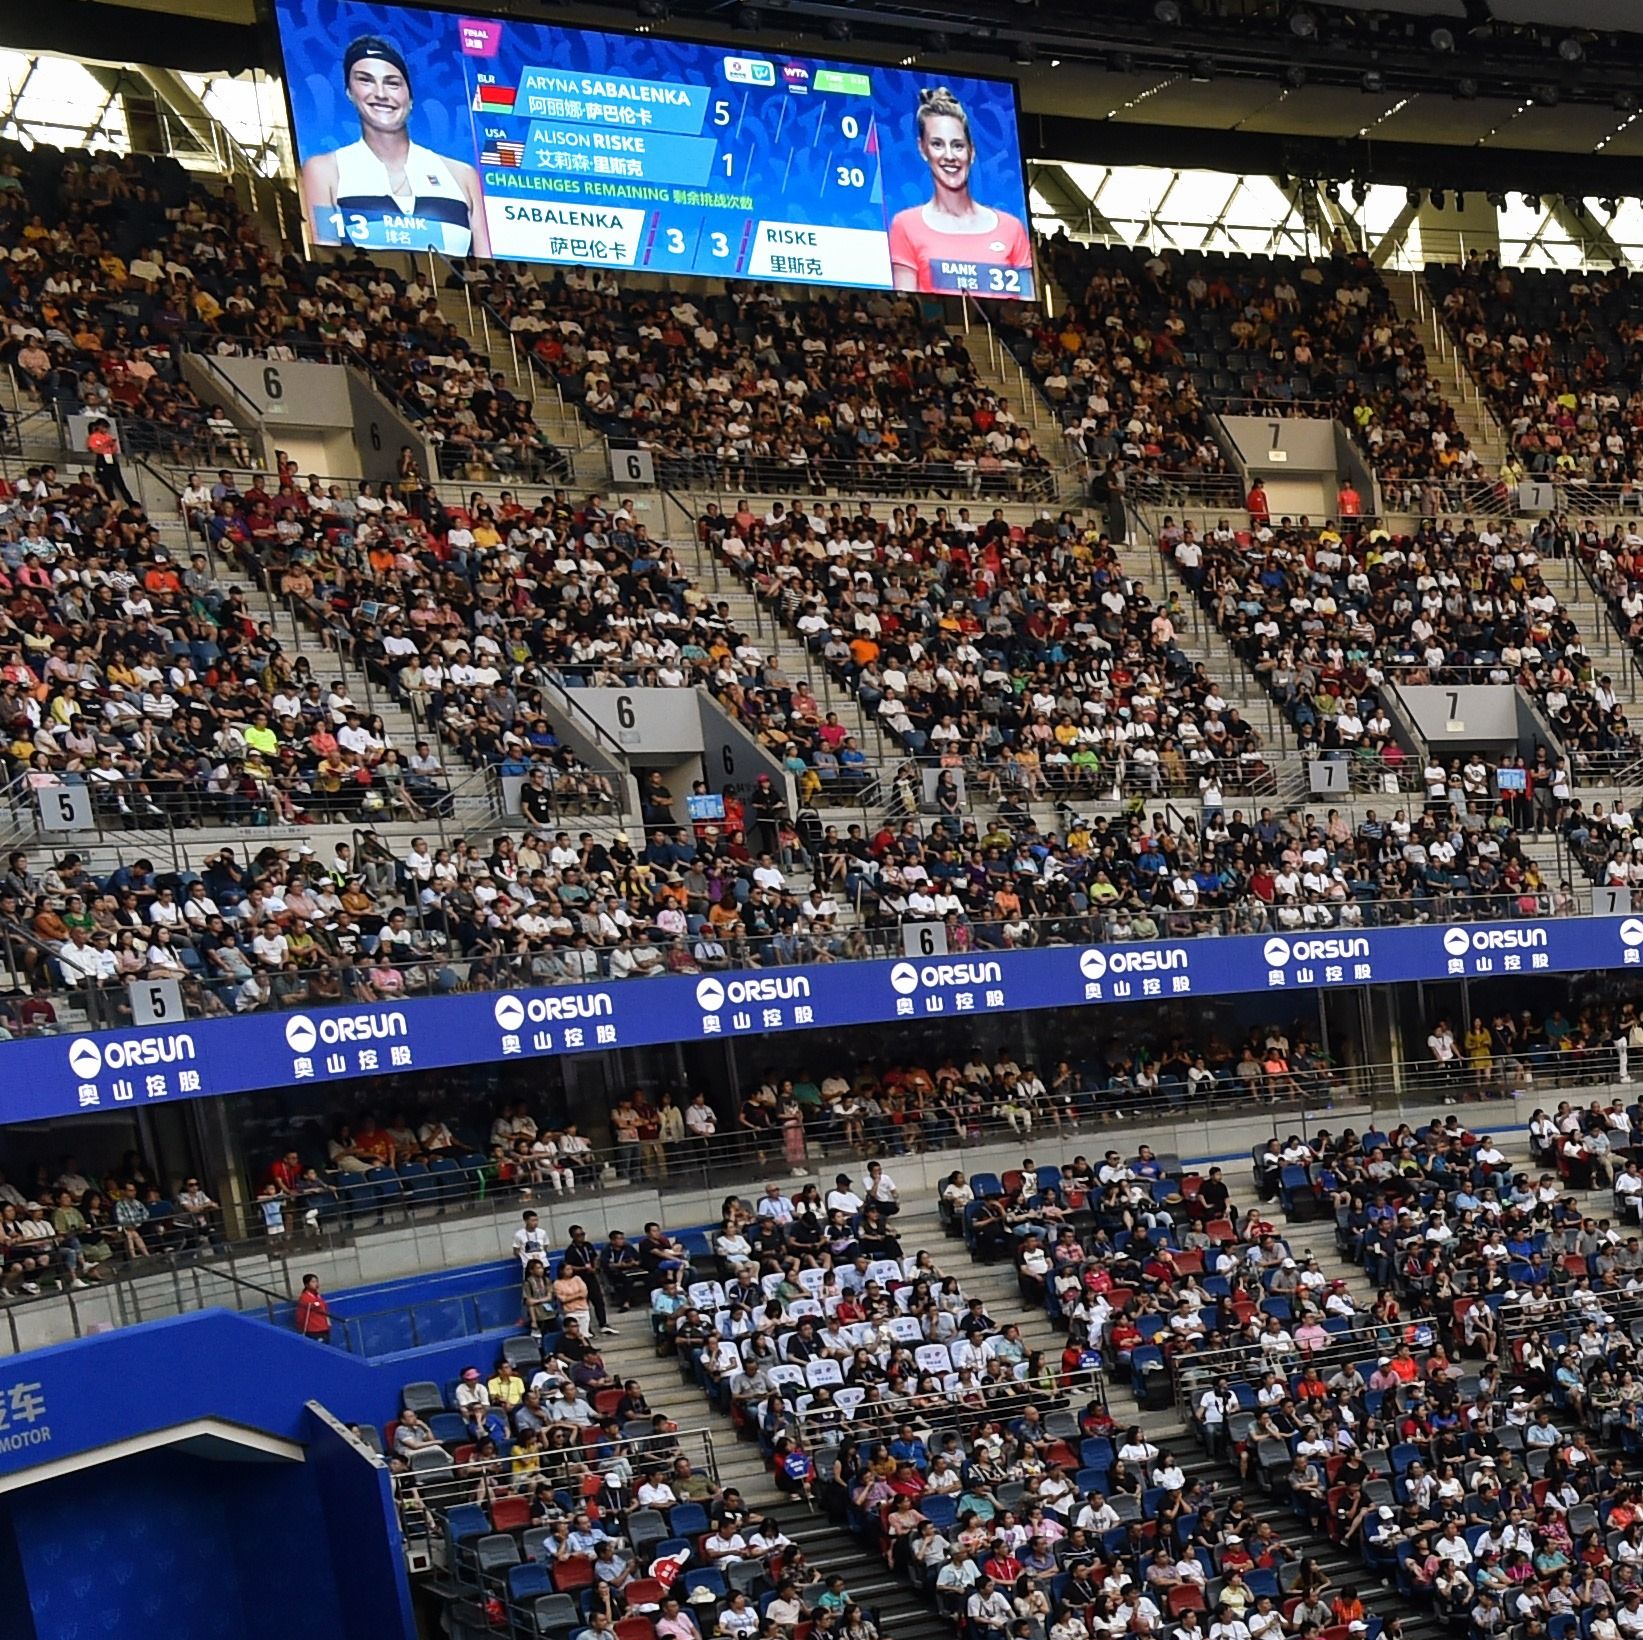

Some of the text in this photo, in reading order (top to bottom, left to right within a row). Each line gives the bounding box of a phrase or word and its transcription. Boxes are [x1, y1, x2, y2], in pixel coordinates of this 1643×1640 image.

[784, 66, 809, 80] WTA
[526, 75, 691, 106] ARYNA SABALENKA
[713, 101, 730, 126] 5
[485, 127, 507, 139] USA
[841, 116, 859, 139] 0
[533, 129, 645, 153] ALISON RISKE
[722, 153, 733, 177] 1
[837, 167, 865, 188] 30
[485, 172, 580, 193] CHALLENGES
[585, 183, 669, 203] REMAINING
[329, 212, 368, 241] 13
[382, 215, 428, 231] RANK
[505, 205, 624, 230] SABALENKA
[549, 236, 628, 260] 萨巴伦卡
[667, 229, 686, 254] 3
[711, 232, 730, 257] 3
[766, 228, 818, 247] RISKE
[770, 255, 824, 276] 里斯克
[941, 261, 978, 277] RANK
[988, 268, 1021, 292] 32
[263, 366, 283, 400] 6
[626, 454, 642, 480] 6
[616, 695, 636, 729] 6
[1445, 692, 1458, 720] 7
[58, 793, 75, 822] 5
[1606, 891, 1617, 913] 7
[919, 927, 935, 956] 6
[1472, 928, 1548, 950] ORSUN
[1447, 952, 1550, 975] 奥山控股
[727, 975, 811, 1004] ORSUN
[149, 987, 166, 1018] 5
[527, 992, 613, 1023] ORSUN
[703, 1004, 814, 1033] 奥山控股
[104, 1034, 196, 1069] ORSUN
[502, 1024, 616, 1054] 奥山控股
[78, 1070, 201, 1106] 奥山控股
[0, 1426, 52, 1454] MOTOR
